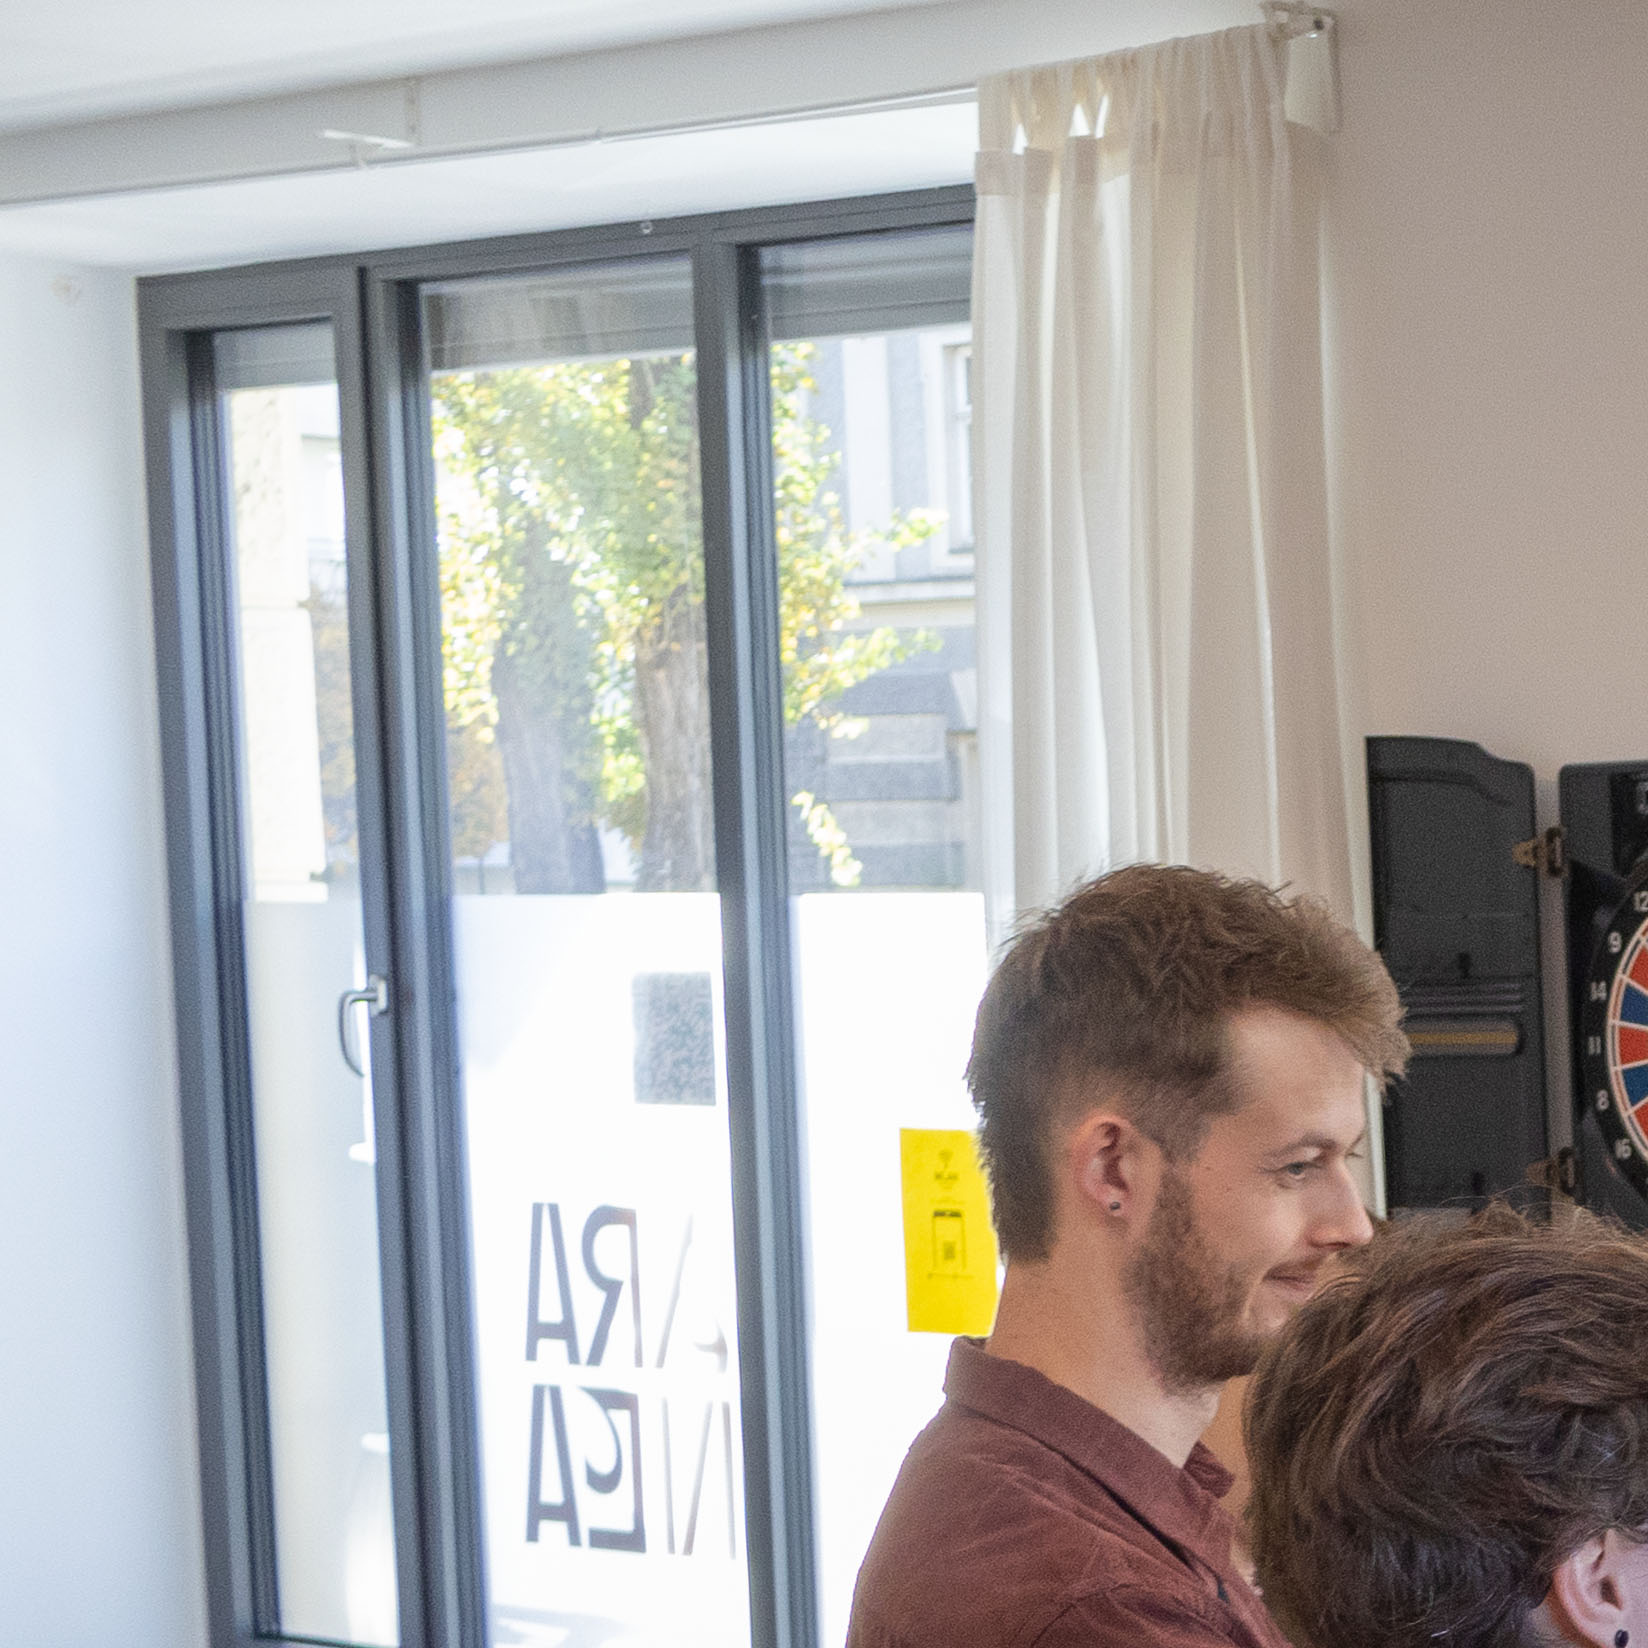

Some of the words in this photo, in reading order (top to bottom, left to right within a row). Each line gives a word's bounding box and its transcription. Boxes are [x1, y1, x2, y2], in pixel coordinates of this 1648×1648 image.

[1609, 932, 1622, 953] 9
[1591, 981, 1607, 1000] 14
[1588, 1037, 1601, 1054] 11
[1597, 1090, 1609, 1110] 8
[1616, 1137, 1634, 1159] 16
